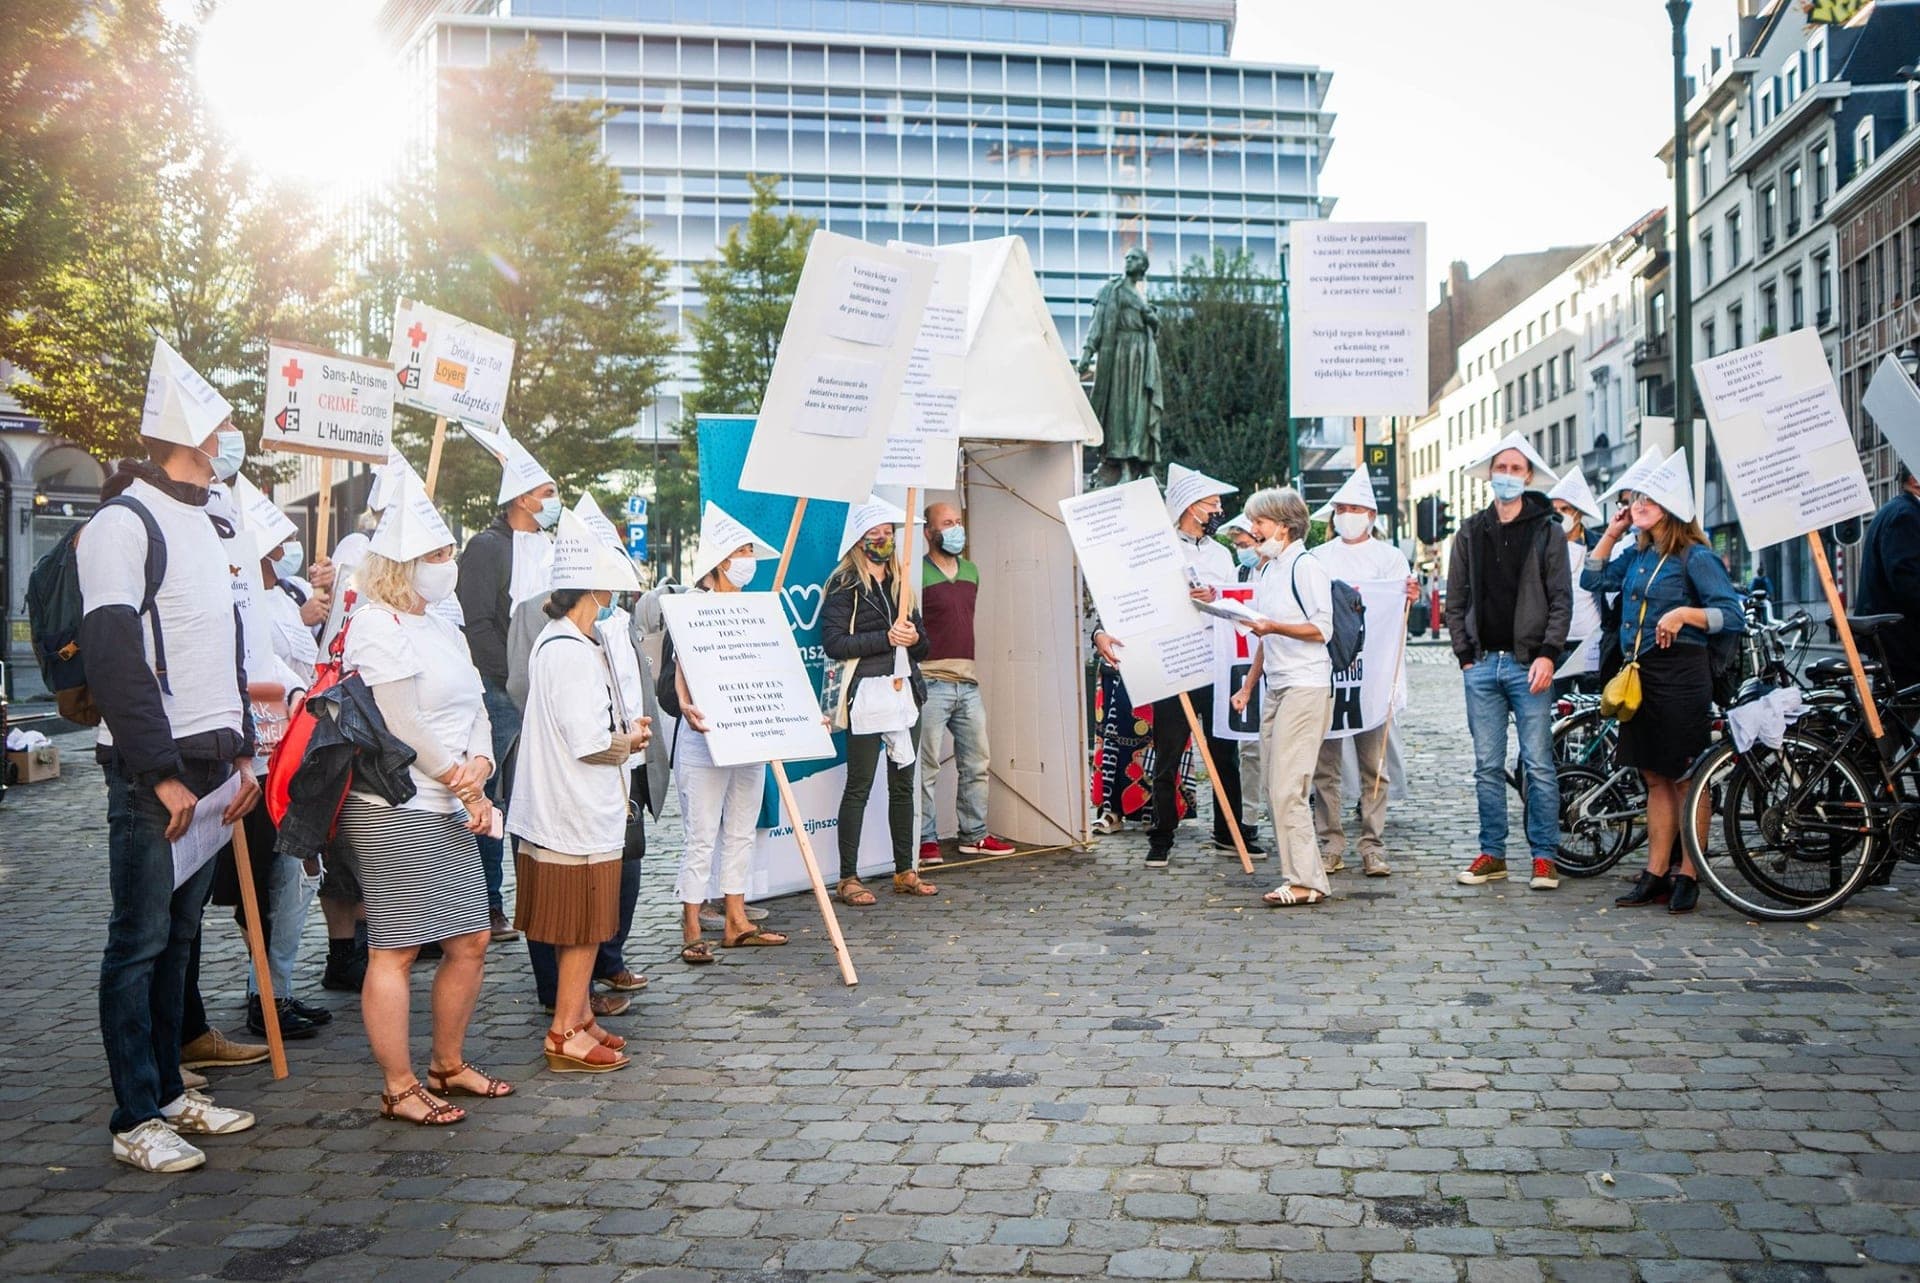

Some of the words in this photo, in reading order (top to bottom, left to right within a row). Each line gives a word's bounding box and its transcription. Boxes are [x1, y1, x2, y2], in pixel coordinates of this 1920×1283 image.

[1360, 235, 1408, 243] patrimoine
[1313, 330, 1338, 338] Strijd
[451, 344, 470, 360] Droit
[1334, 343, 1377, 352] erkenning
[322, 365, 387, 390] Sans-Abrisme
[436, 364, 466, 382] Loyers
[318, 393, 359, 414] CRIME
[361, 404, 387, 419] contre
[452, 390, 490, 412] adaptés
[318, 421, 384, 447] L'Humanité
[1374, 450, 1384, 463] P
[630, 527, 644, 548] P
[698, 608, 726, 616] DROIT
[688, 619, 741, 628] LOGEMENT
[741, 617, 766, 626] POUR
[692, 642, 715, 652] Appel
[728, 640, 779, 651] gouvernement
[718, 682, 750, 692] RECHT
[728, 694, 756, 703] THUIS
[757, 692, 784, 700] VOOR
[716, 719, 748, 730] Oproep
[775, 715, 809, 723] Brusselse
